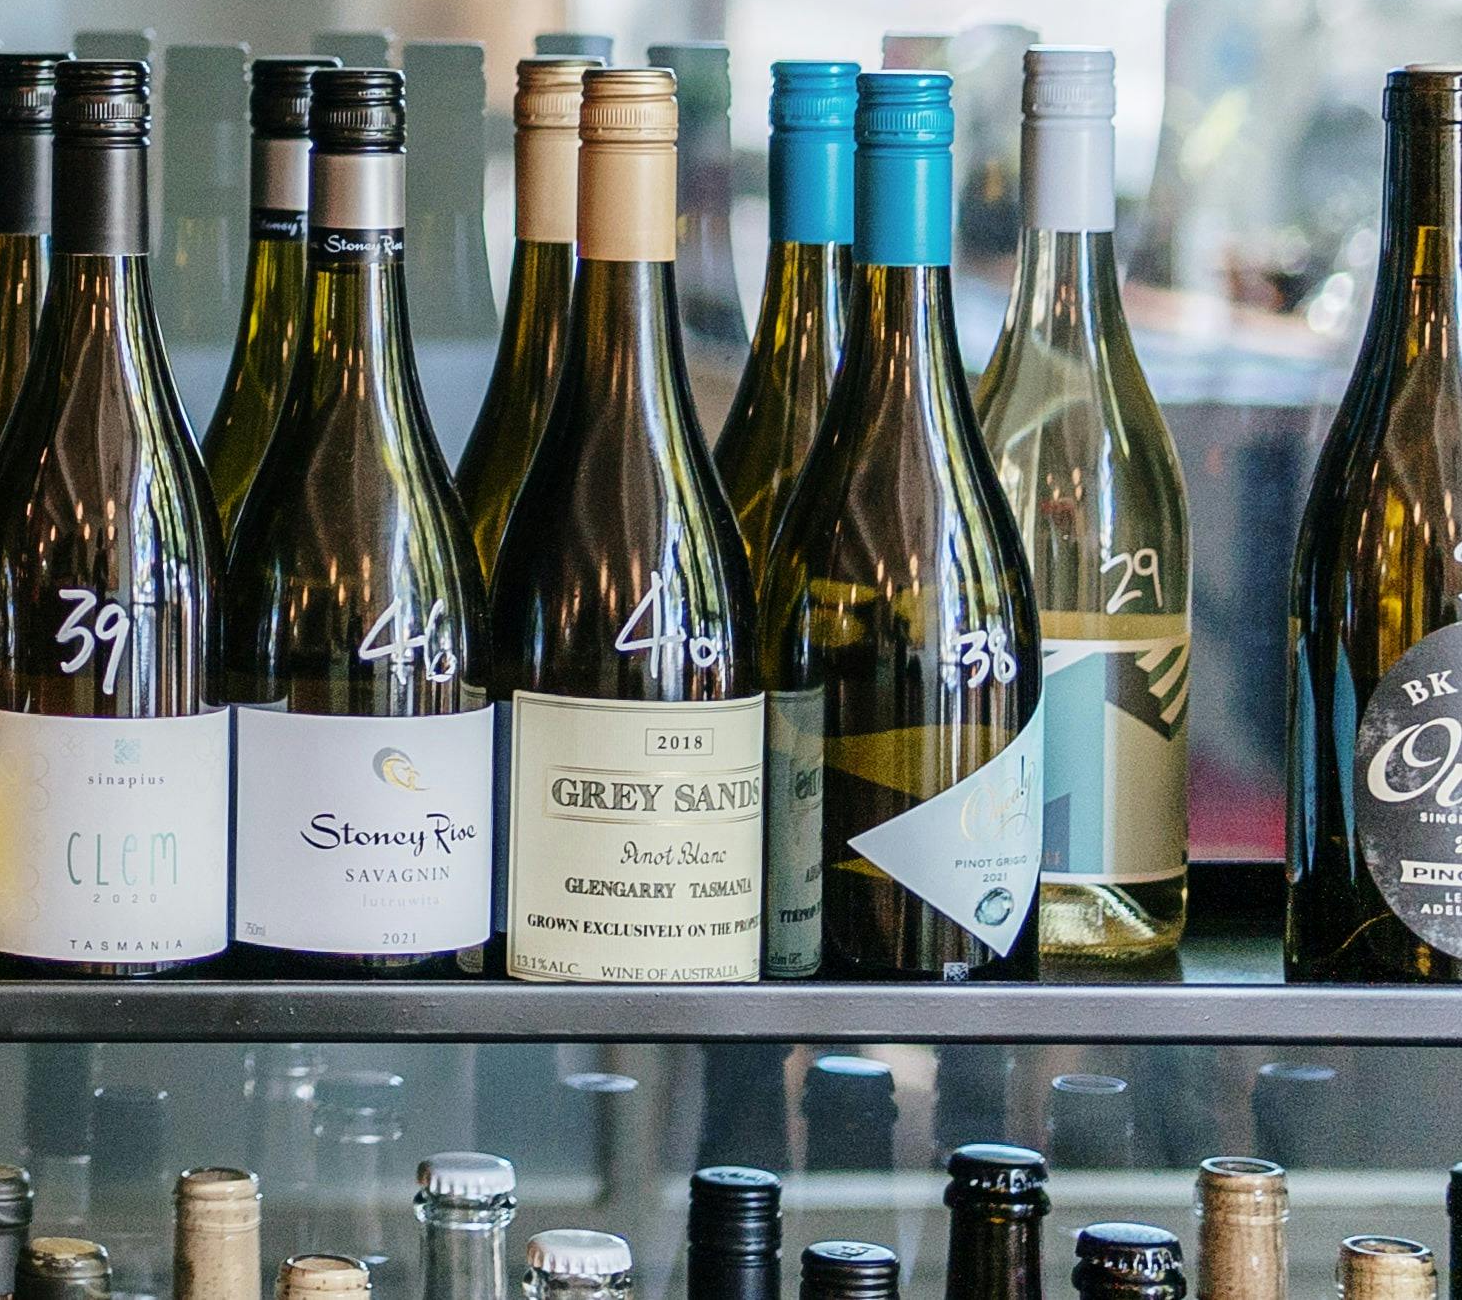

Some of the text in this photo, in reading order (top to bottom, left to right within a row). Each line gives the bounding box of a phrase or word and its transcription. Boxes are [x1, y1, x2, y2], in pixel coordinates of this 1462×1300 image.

[1100, 547, 1163, 615] 29
[615, 570, 717, 678] 40
[56, 589, 132, 696] 39
[359, 598, 458, 684] 46
[955, 629, 1017, 689] 38
[1401, 669, 1458, 707] BK
[657, 735, 703, 750] 2018
[87, 772, 165, 789] sinapius
[552, 776, 761, 812] GREY SANDS
[299, 812, 478, 857] Stoney Rise
[955, 856, 1027, 870] PINOT GRIGIO
[345, 865, 450, 883] SAVAGNIN
[983, 872, 1008, 882] 2021
[564, 877, 753, 899] GLENGARRY TASMANIA
[92, 893, 158, 904] 2020
[69, 938, 183, 952] TASMANIA
[382, 933, 418, 944] 2021
[601, 964, 739, 980] WINE OF AUSTRALIA
